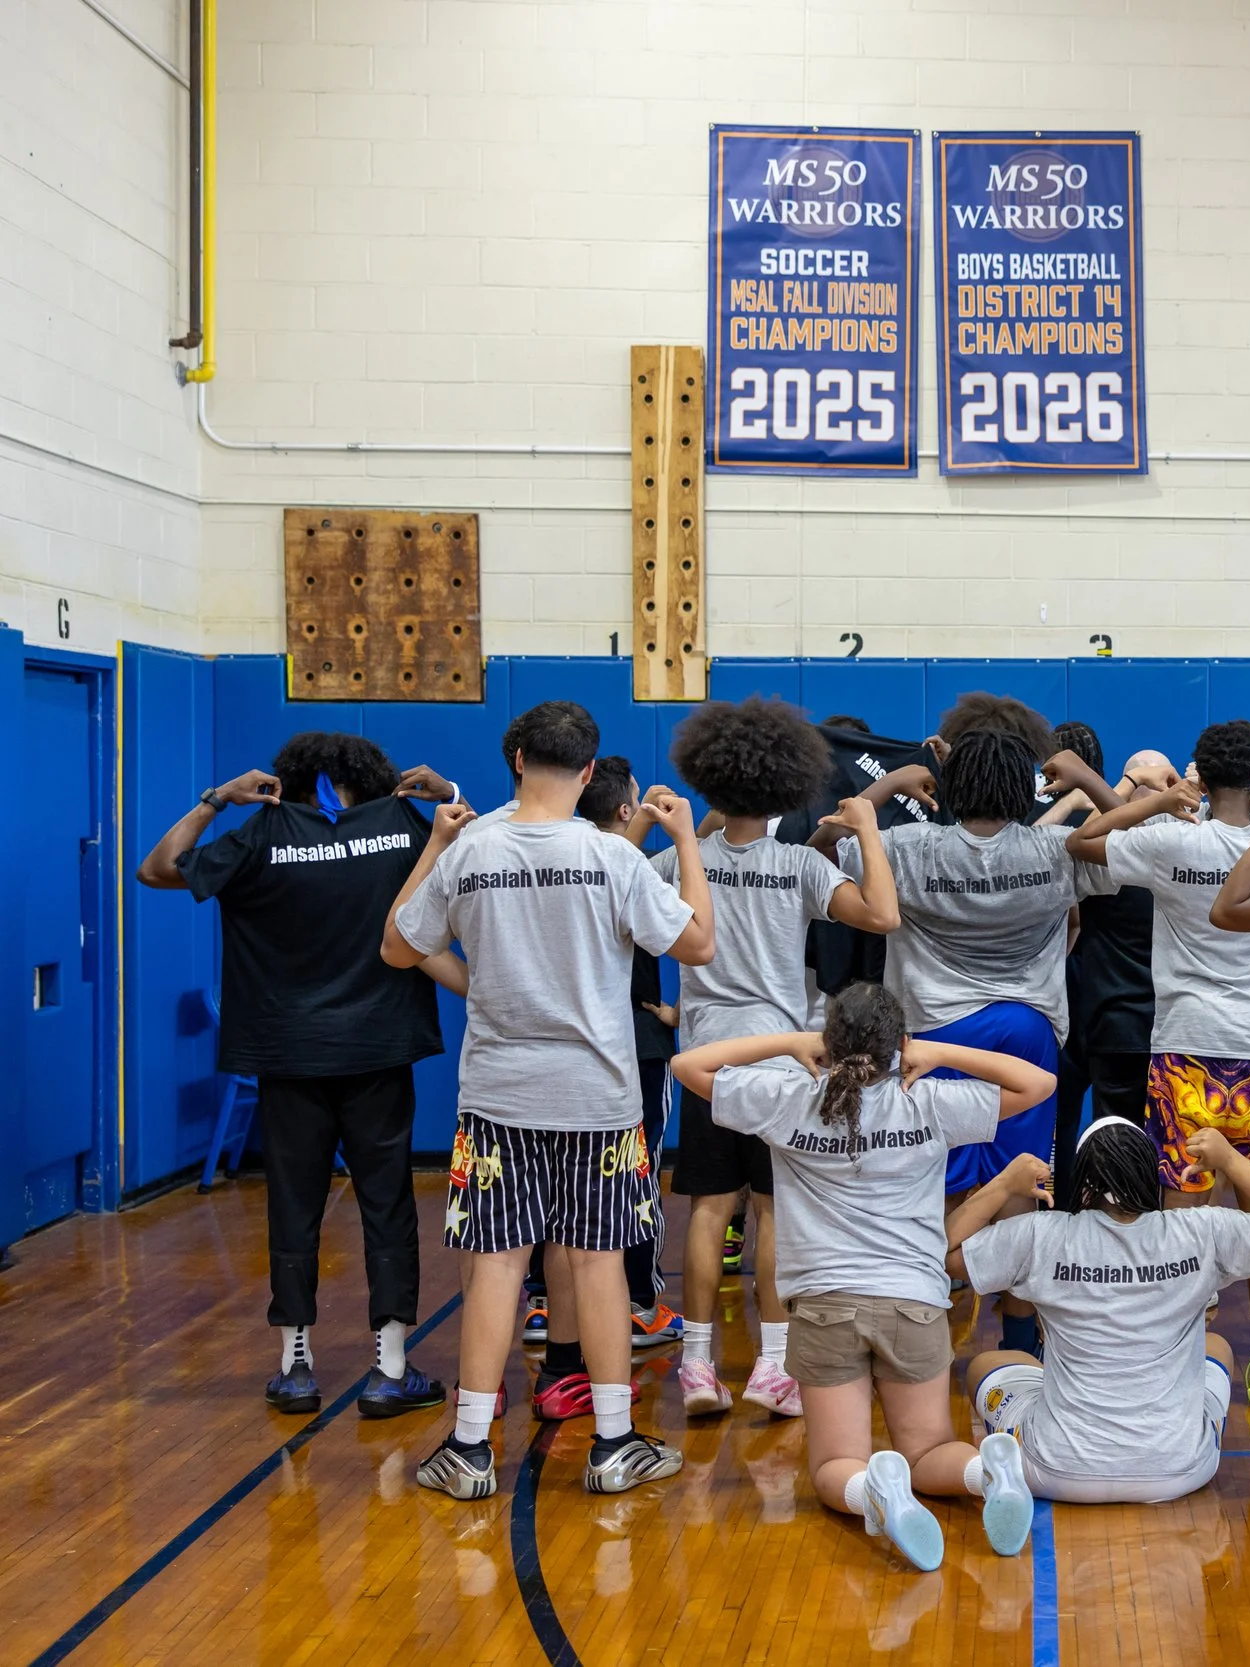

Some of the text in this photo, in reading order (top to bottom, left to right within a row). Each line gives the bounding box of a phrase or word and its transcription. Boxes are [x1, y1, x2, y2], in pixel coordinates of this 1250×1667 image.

[763, 158, 867, 196] MS 50
[985, 164, 1088, 200] MS 50
[728, 198, 902, 227] WARRIORS
[952, 204, 1124, 230] WARRIORS
[760, 248, 869, 277] SOCCER
[957, 252, 1121, 280] BOYS BASKETBALL
[730, 279, 898, 316] MSAL FALL DIVISION
[957, 284, 1122, 318] DISTRICT 14
[730, 317, 898, 353] CHAMPIONS
[958, 322, 1123, 355] CHAMPIONS
[729, 367, 896, 442] 2025
[960, 371, 1124, 443] 2026
[608, 631, 619, 657] 1
[839, 632, 864, 658] 2
[270, 833, 410, 864] Jahsaiah Watson
[457, 868, 605, 896] Jahsaiah Watson
[742, 871, 797, 890] Watson
[924, 870, 1051, 894] Jahsaiah Watson
[1171, 866, 1234, 885] Jahsaia
[871, 1126, 933, 1149] Watson
[1053, 1256, 1200, 1284] Jahsaiah Watson
